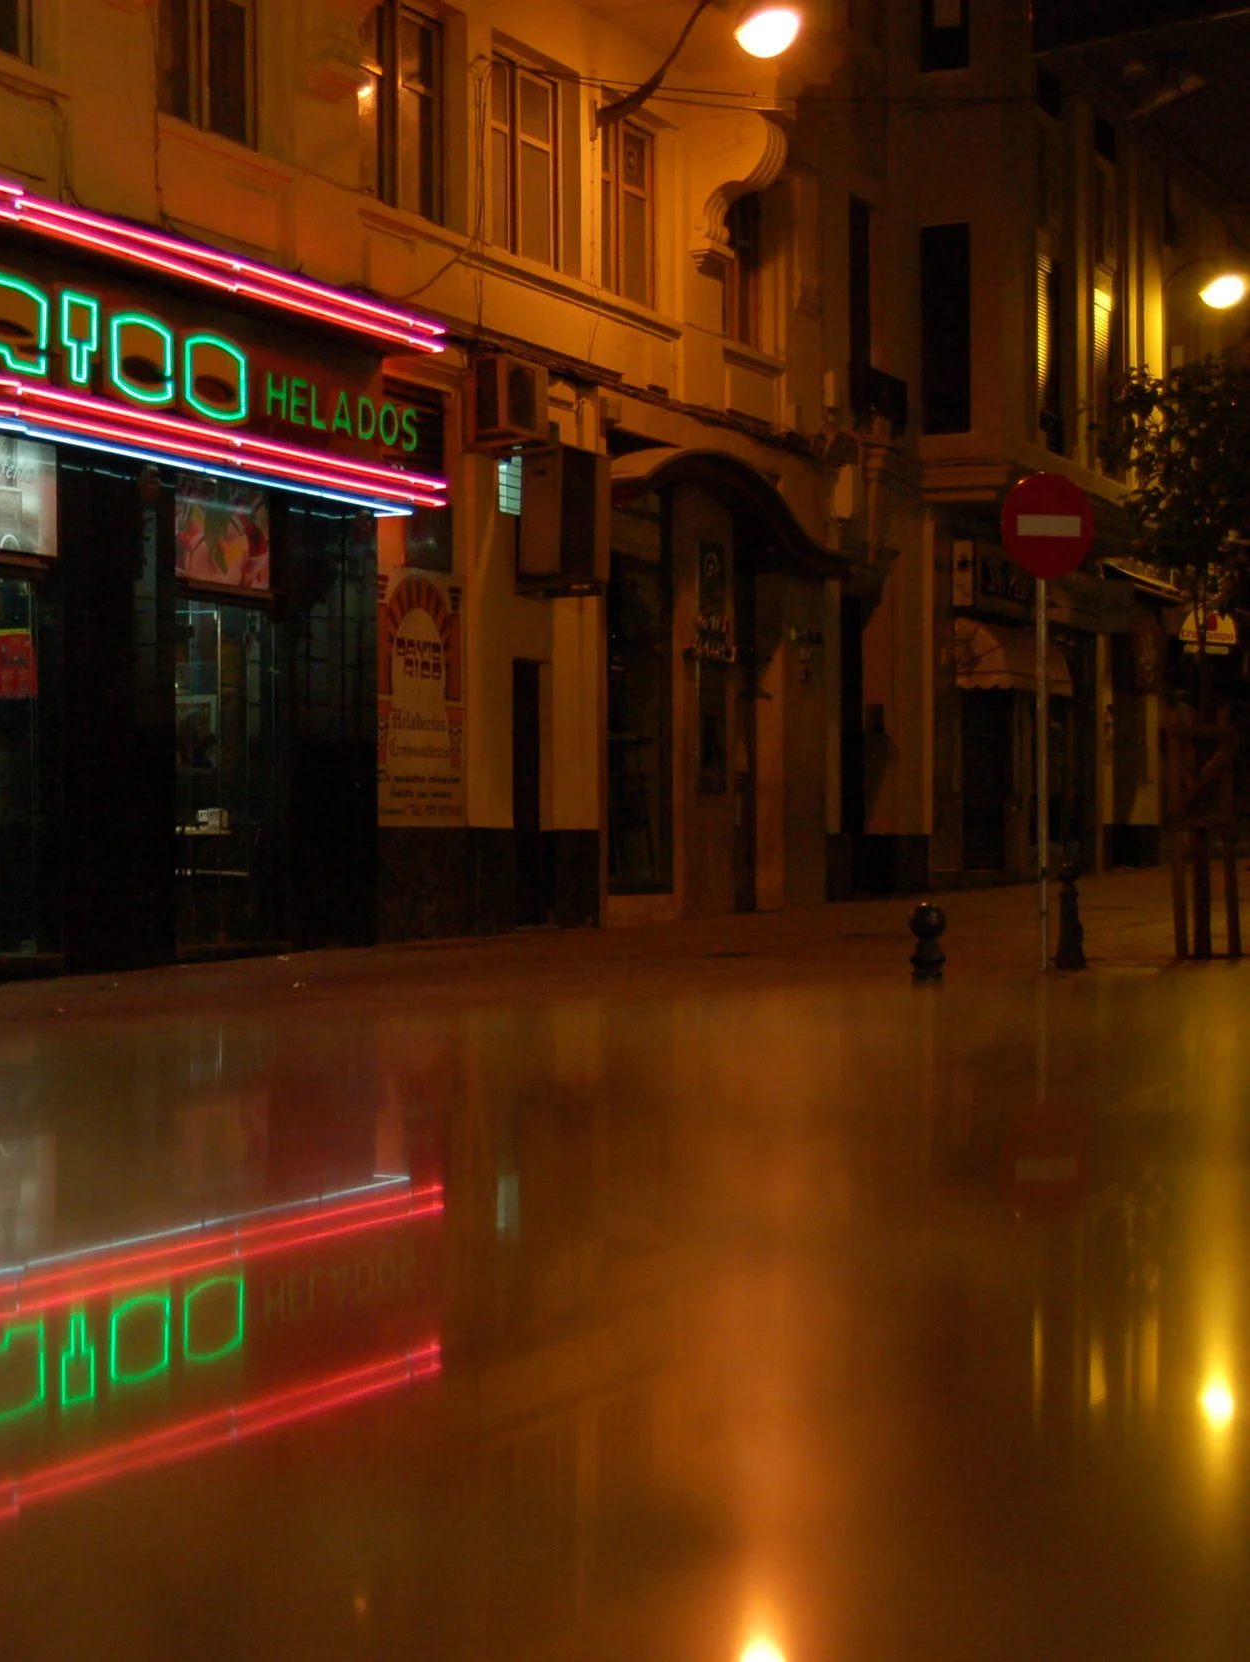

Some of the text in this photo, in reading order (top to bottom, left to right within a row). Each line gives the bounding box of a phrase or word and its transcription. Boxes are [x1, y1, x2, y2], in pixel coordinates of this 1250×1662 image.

[265, 371, 418, 452] HELADOS
[1181, 629, 1234, 641] Cruampo
[404, 657, 442, 680] RICO
